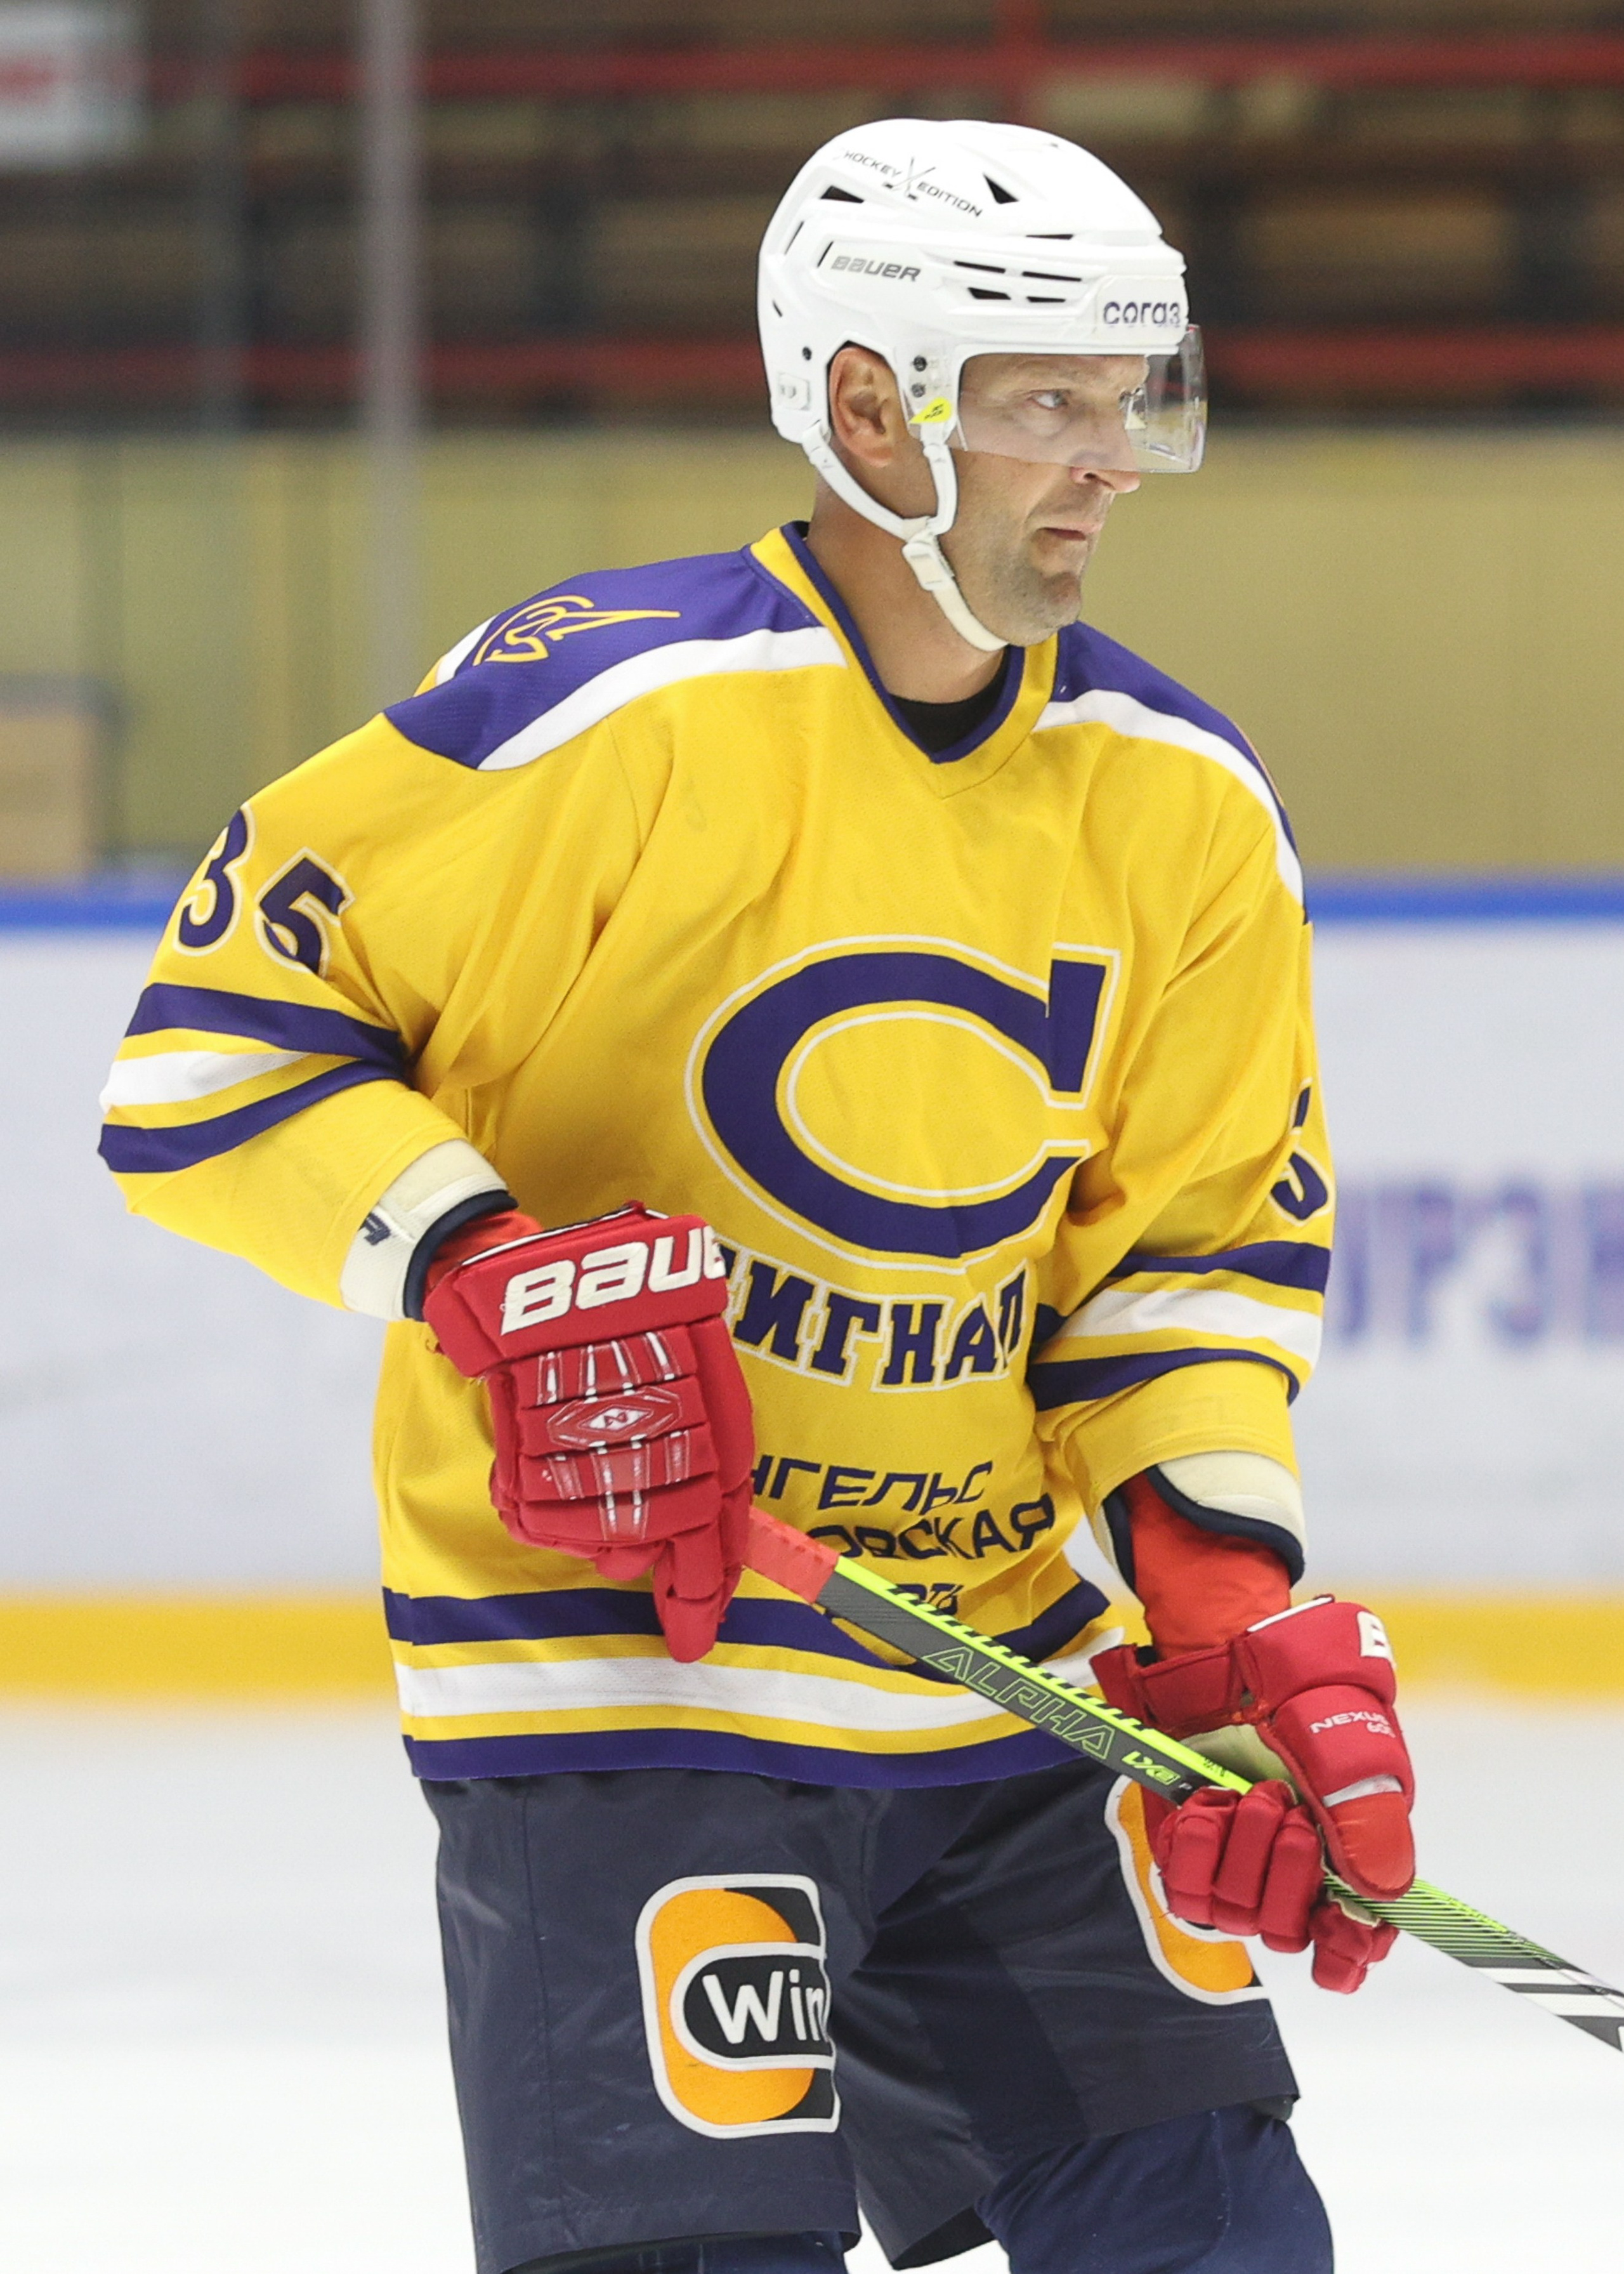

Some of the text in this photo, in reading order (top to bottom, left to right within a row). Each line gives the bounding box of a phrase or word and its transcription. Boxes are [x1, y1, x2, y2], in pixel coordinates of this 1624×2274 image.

[844, 150, 983, 218] HOCKEY EDITION
[171, 802, 357, 978] 35
[721, 1245, 1030, 1395] ИГНАЛ
[920, 1646, 1116, 1760] ALPHA
